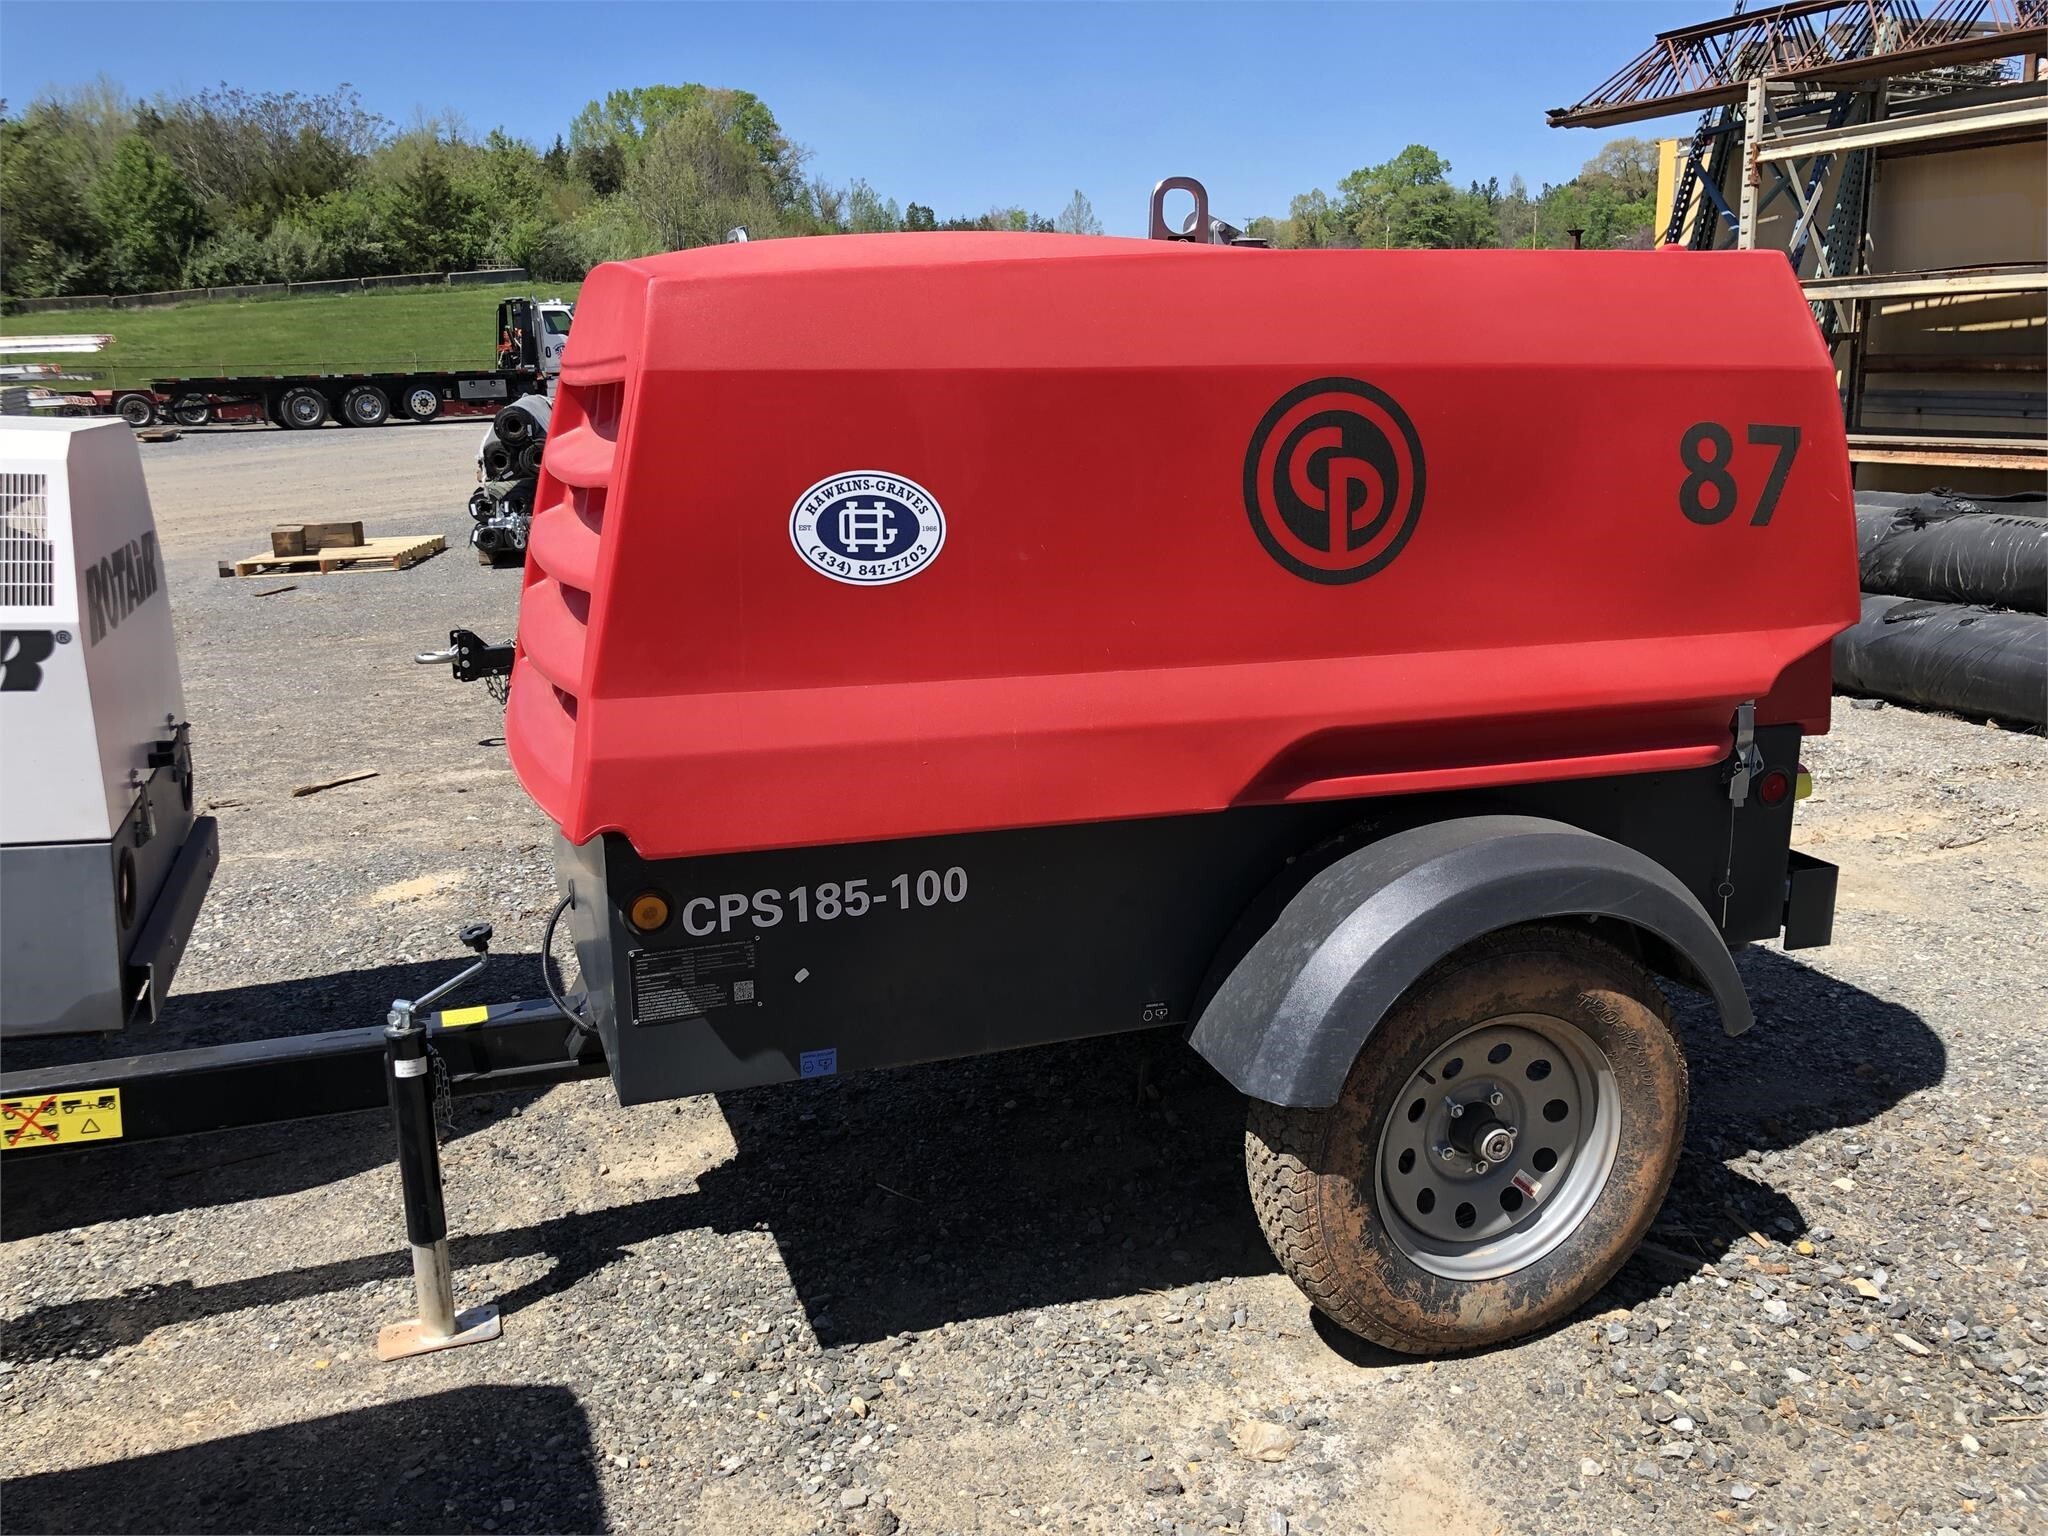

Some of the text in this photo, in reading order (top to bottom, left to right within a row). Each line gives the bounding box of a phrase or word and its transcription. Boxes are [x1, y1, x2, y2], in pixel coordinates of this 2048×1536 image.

[805, 479, 929, 516] HAWKINS-GRAVES
[1679, 422, 1802, 526] 87
[810, 544, 928, 576] (434) 847-7703
[682, 866, 968, 936] CPS185-100
